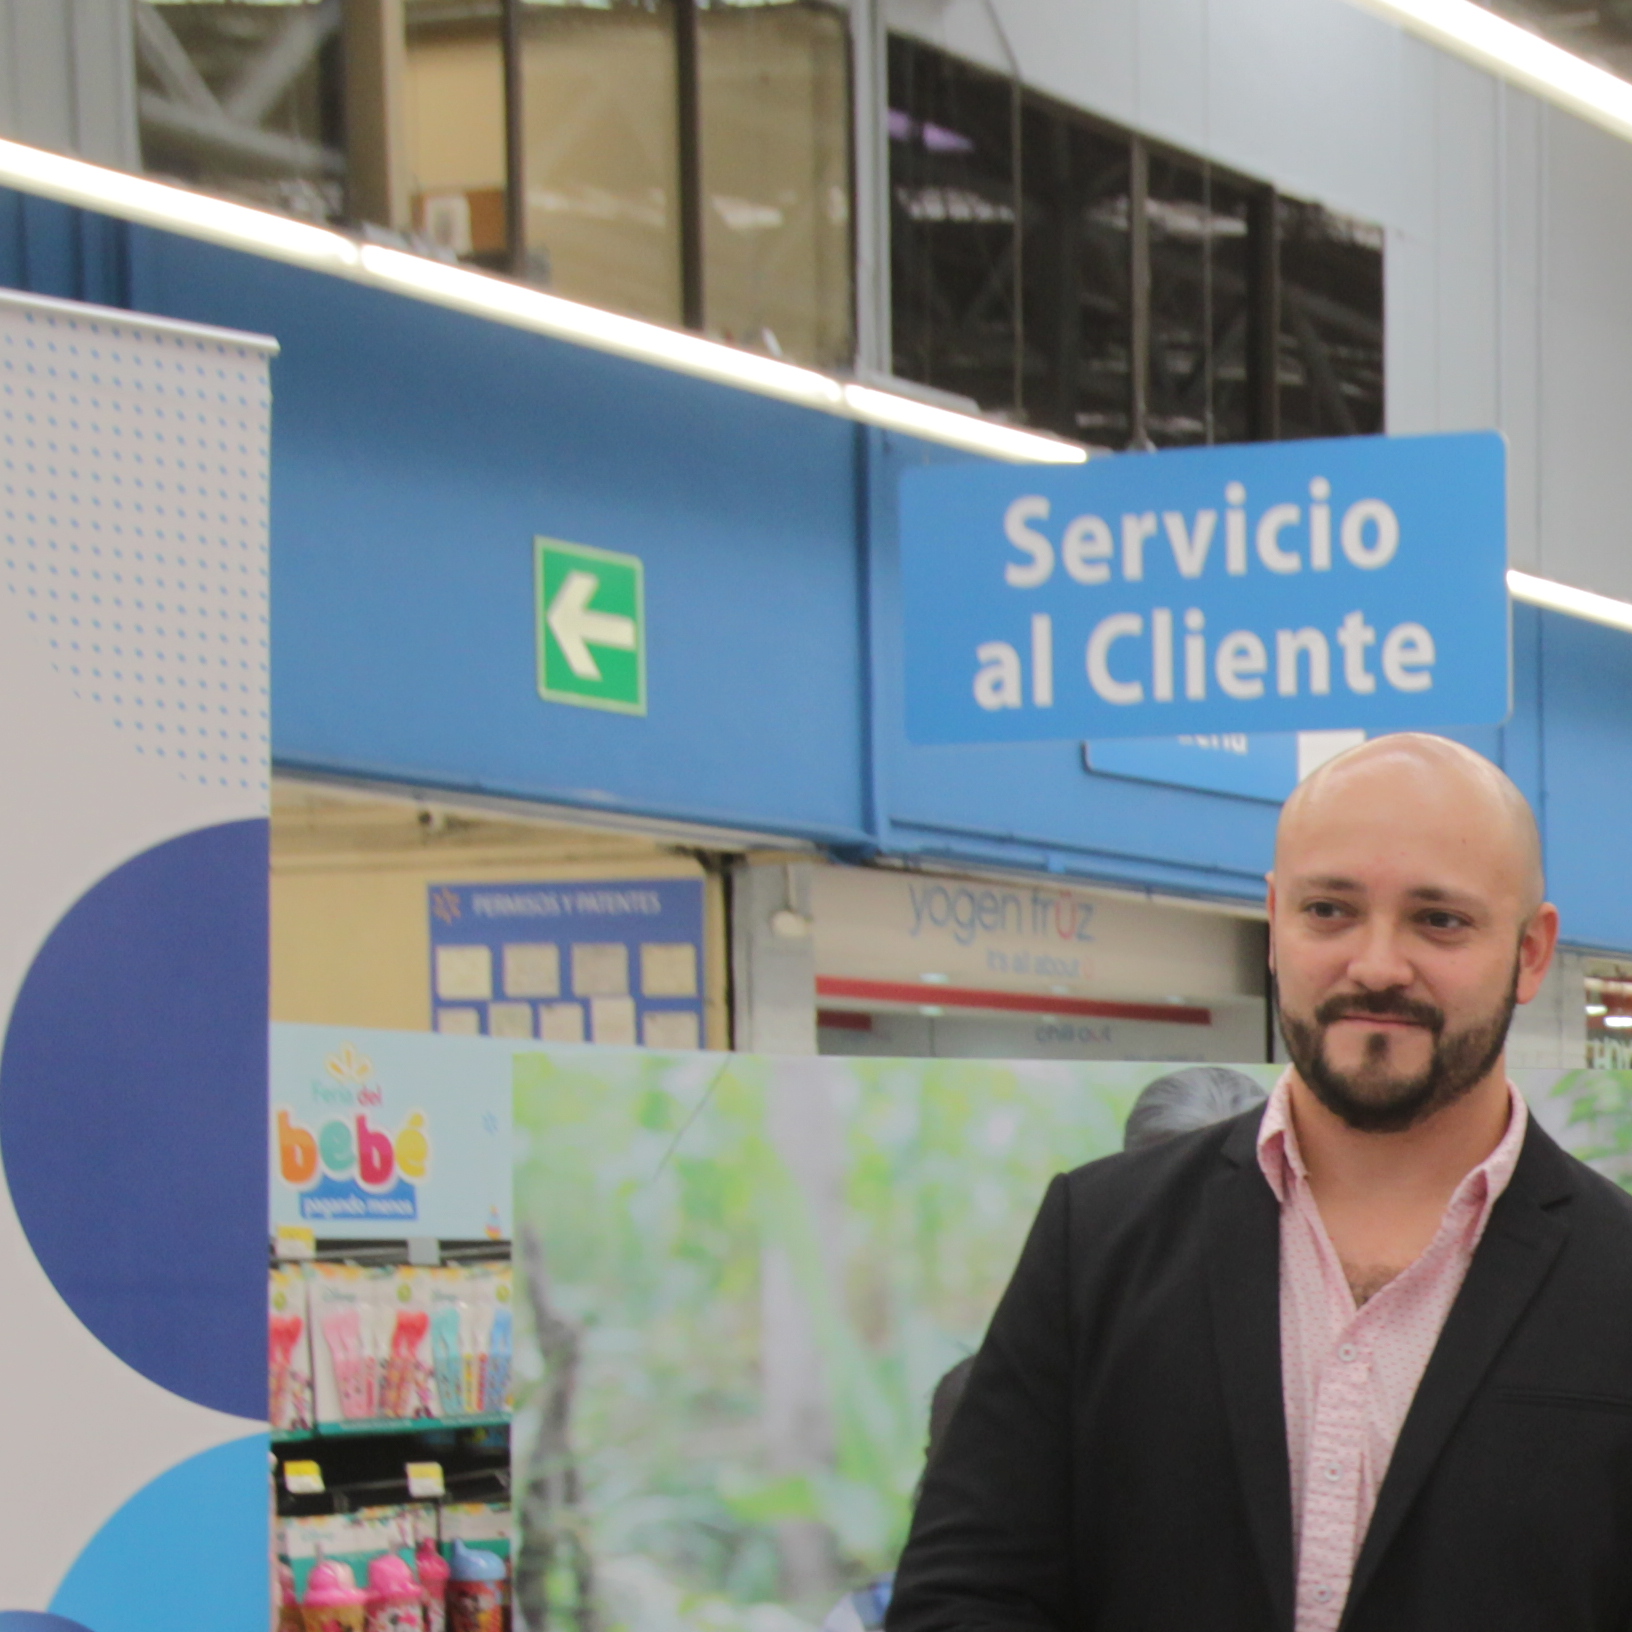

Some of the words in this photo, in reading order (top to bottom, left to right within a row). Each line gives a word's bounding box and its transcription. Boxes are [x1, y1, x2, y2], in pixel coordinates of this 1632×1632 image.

[1004, 476, 1400, 588] Servicio
[973, 614, 1053, 710] al
[1086, 607, 1436, 704] Cliente
[908, 884, 1024, 947] yogen
[278, 1110, 429, 1186] bebé
